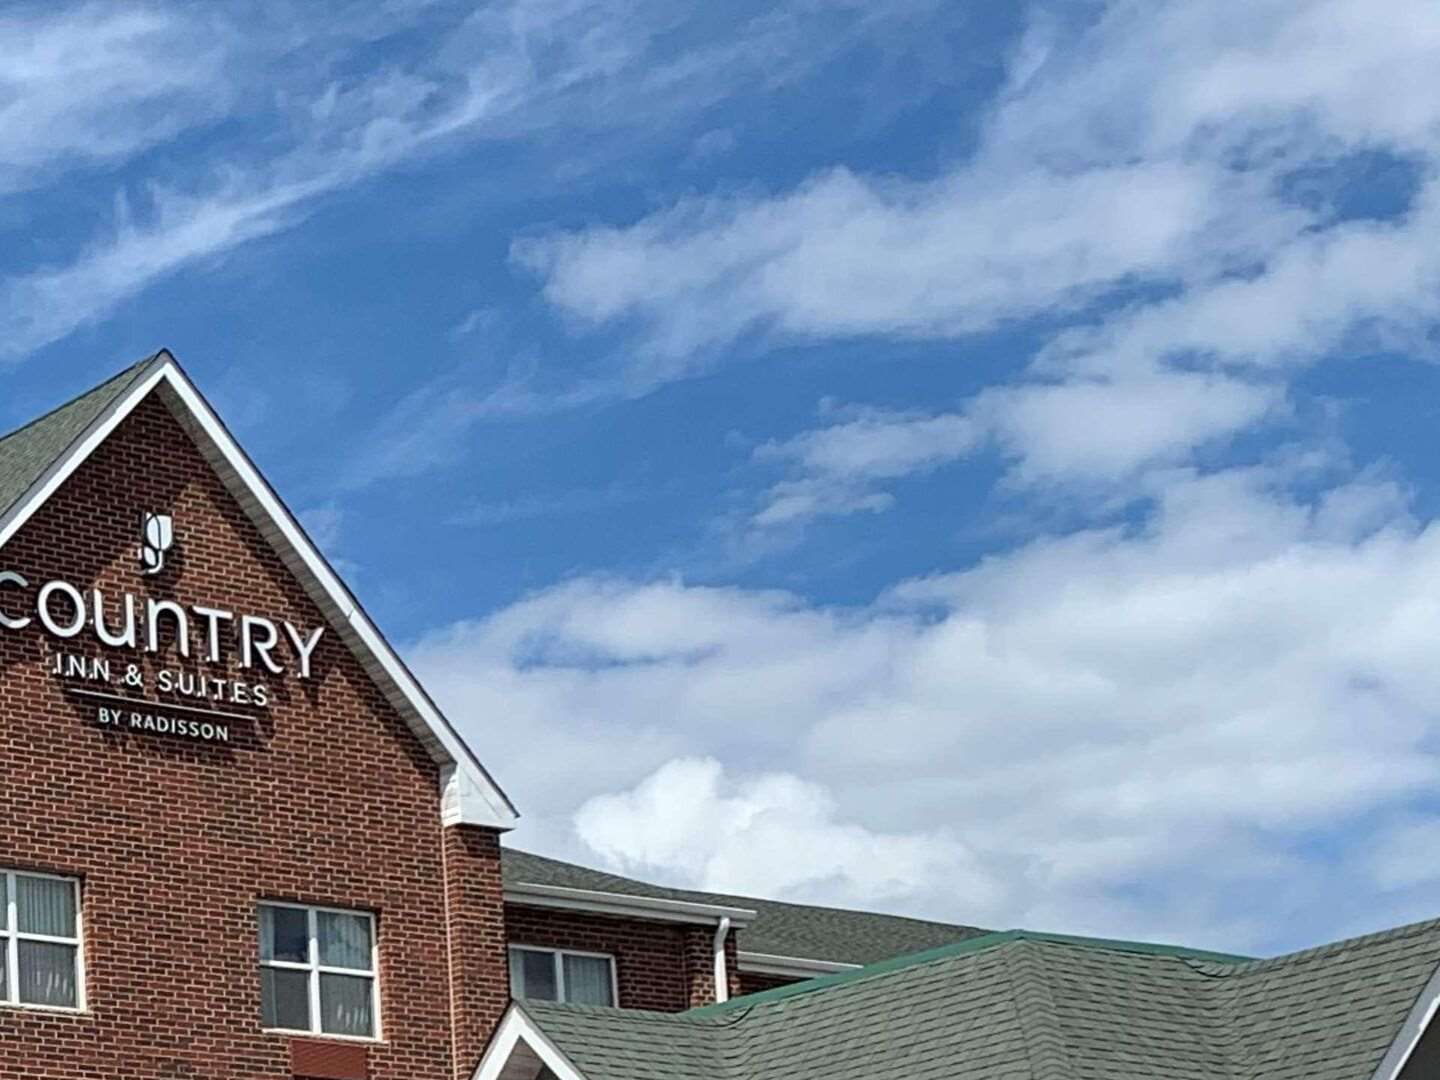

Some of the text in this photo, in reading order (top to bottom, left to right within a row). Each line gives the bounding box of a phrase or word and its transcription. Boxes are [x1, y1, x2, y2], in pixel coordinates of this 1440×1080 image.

[54, 653, 267, 706] INN & SUITES
[99, 708, 228, 741] BY RADISSON
